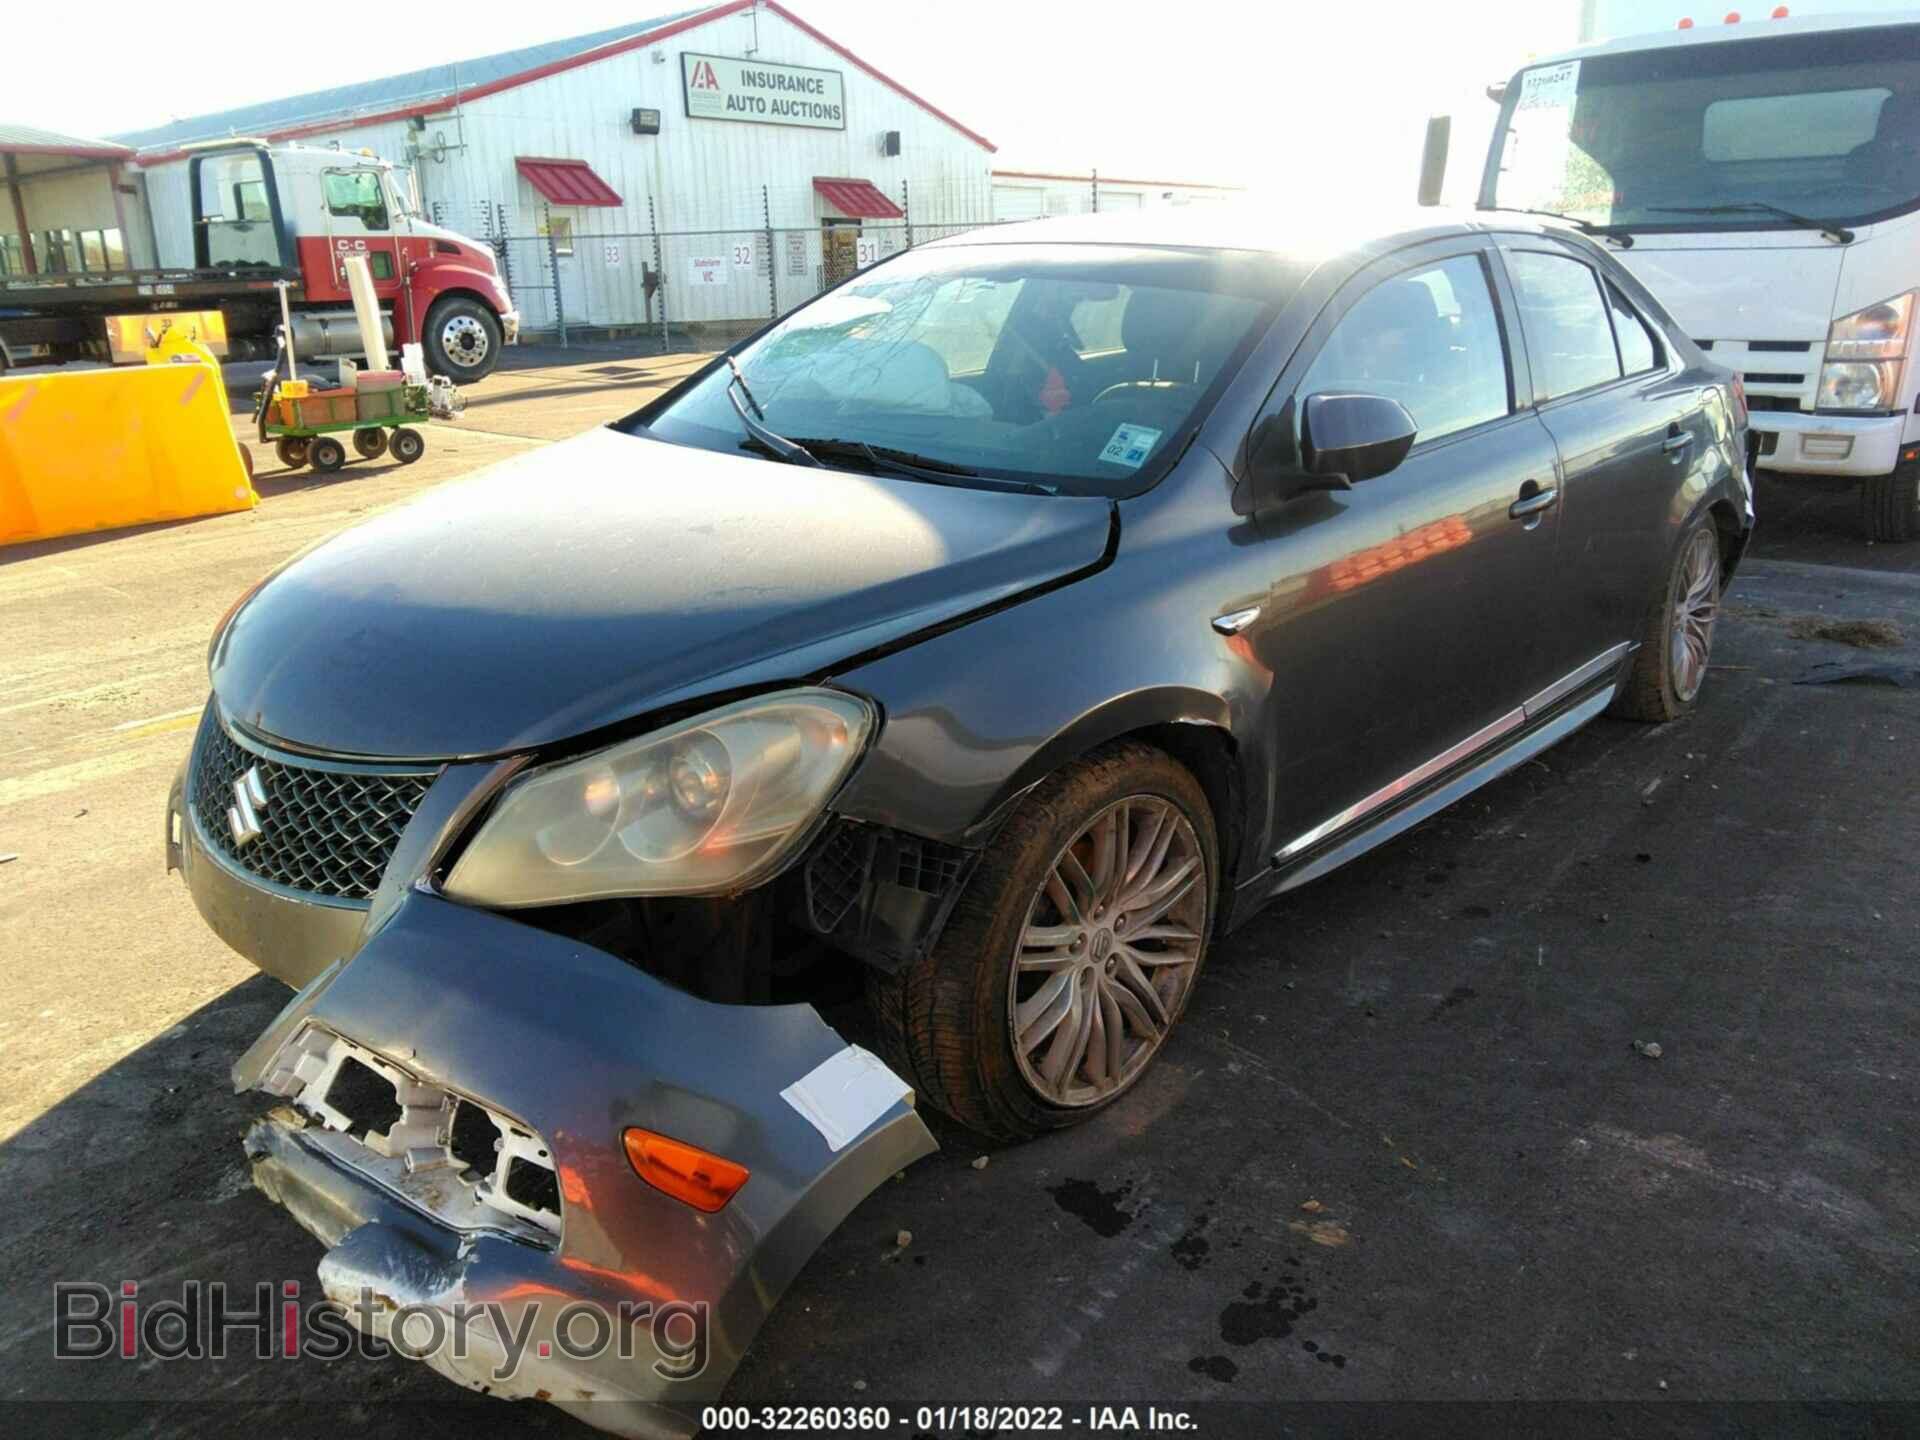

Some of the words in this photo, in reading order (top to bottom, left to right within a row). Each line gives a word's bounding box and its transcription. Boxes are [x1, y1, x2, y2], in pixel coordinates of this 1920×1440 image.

[741, 70, 825, 95] INSURANCE
[726, 94, 767, 114] AUTO
[771, 97, 842, 121] AUCTIONS
[605, 246, 620, 264] 33
[734, 246, 751, 265] 32
[859, 243, 875, 263] 31
